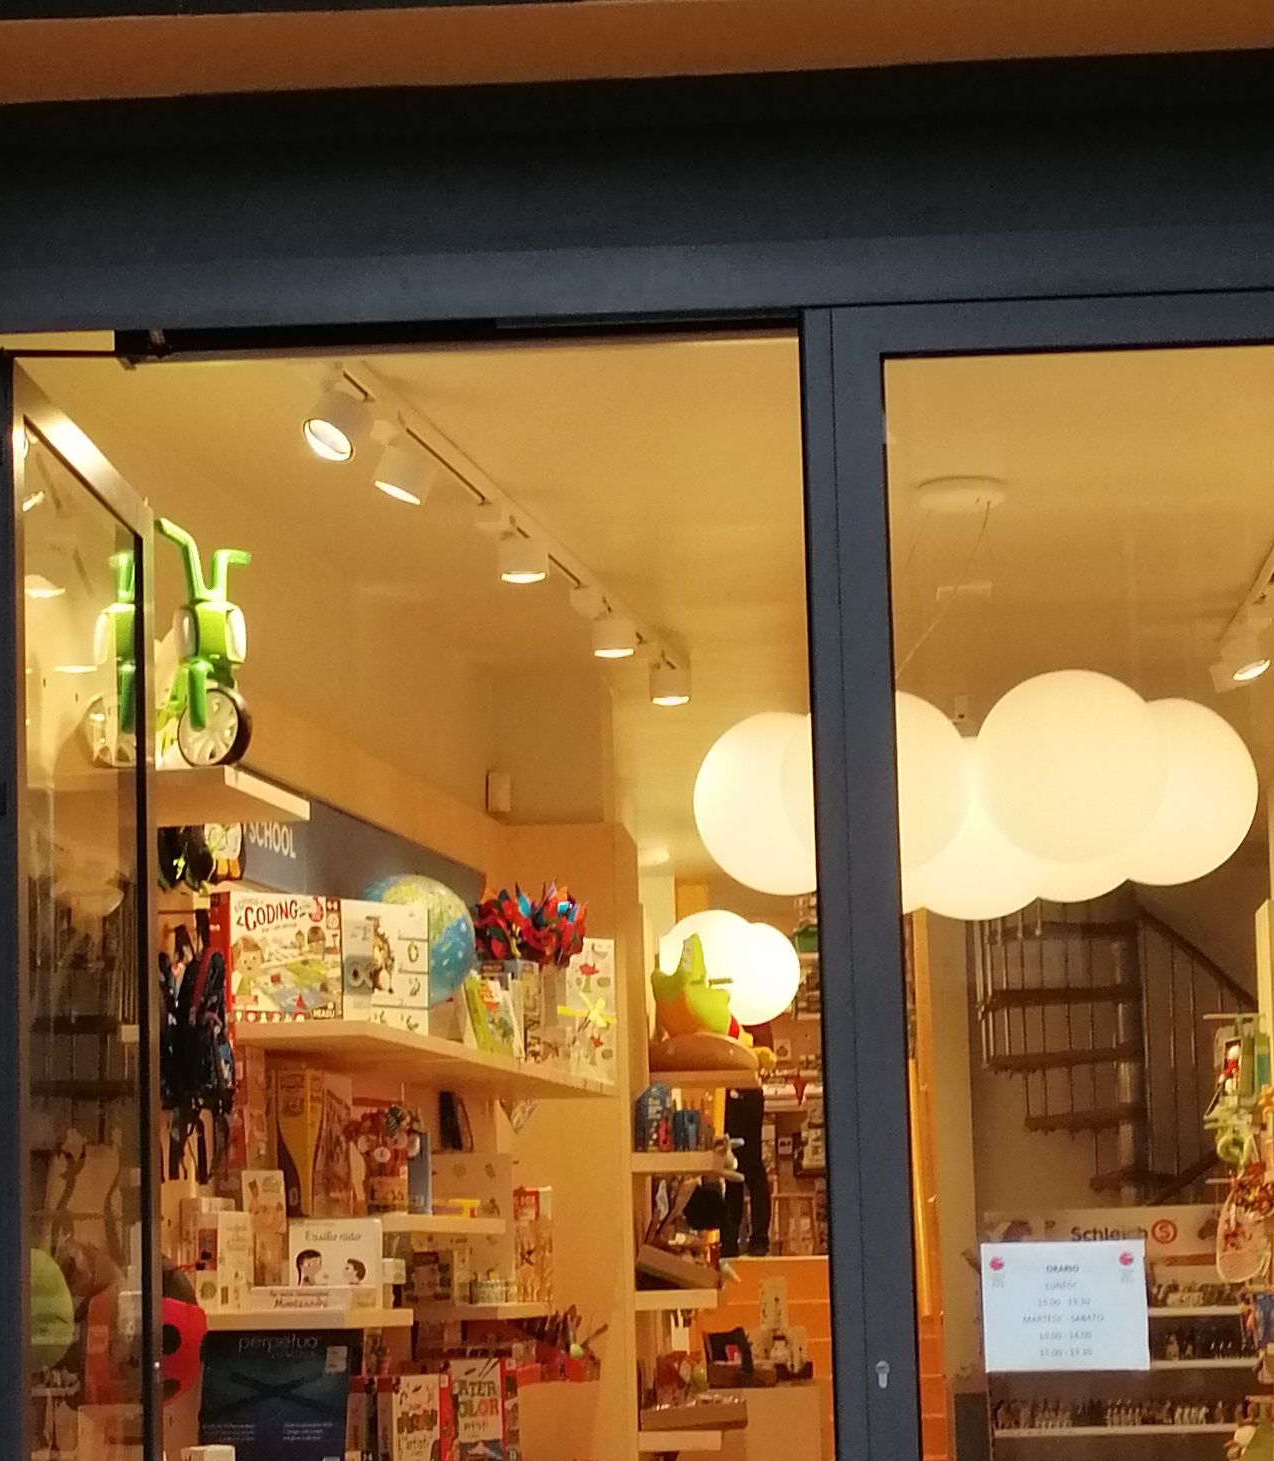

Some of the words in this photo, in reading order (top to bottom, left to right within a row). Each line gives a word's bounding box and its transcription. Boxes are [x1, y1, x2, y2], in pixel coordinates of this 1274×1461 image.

[249, 821, 296, 859] SCHOOL
[244, 898, 299, 932] CODING
[1070, 1225, 1148, 1241] Schleh
[1046, 1264, 1080, 1274] ORARIO
[458, 1379, 496, 1397] ATER
[458, 1398, 499, 1419] OLOR
